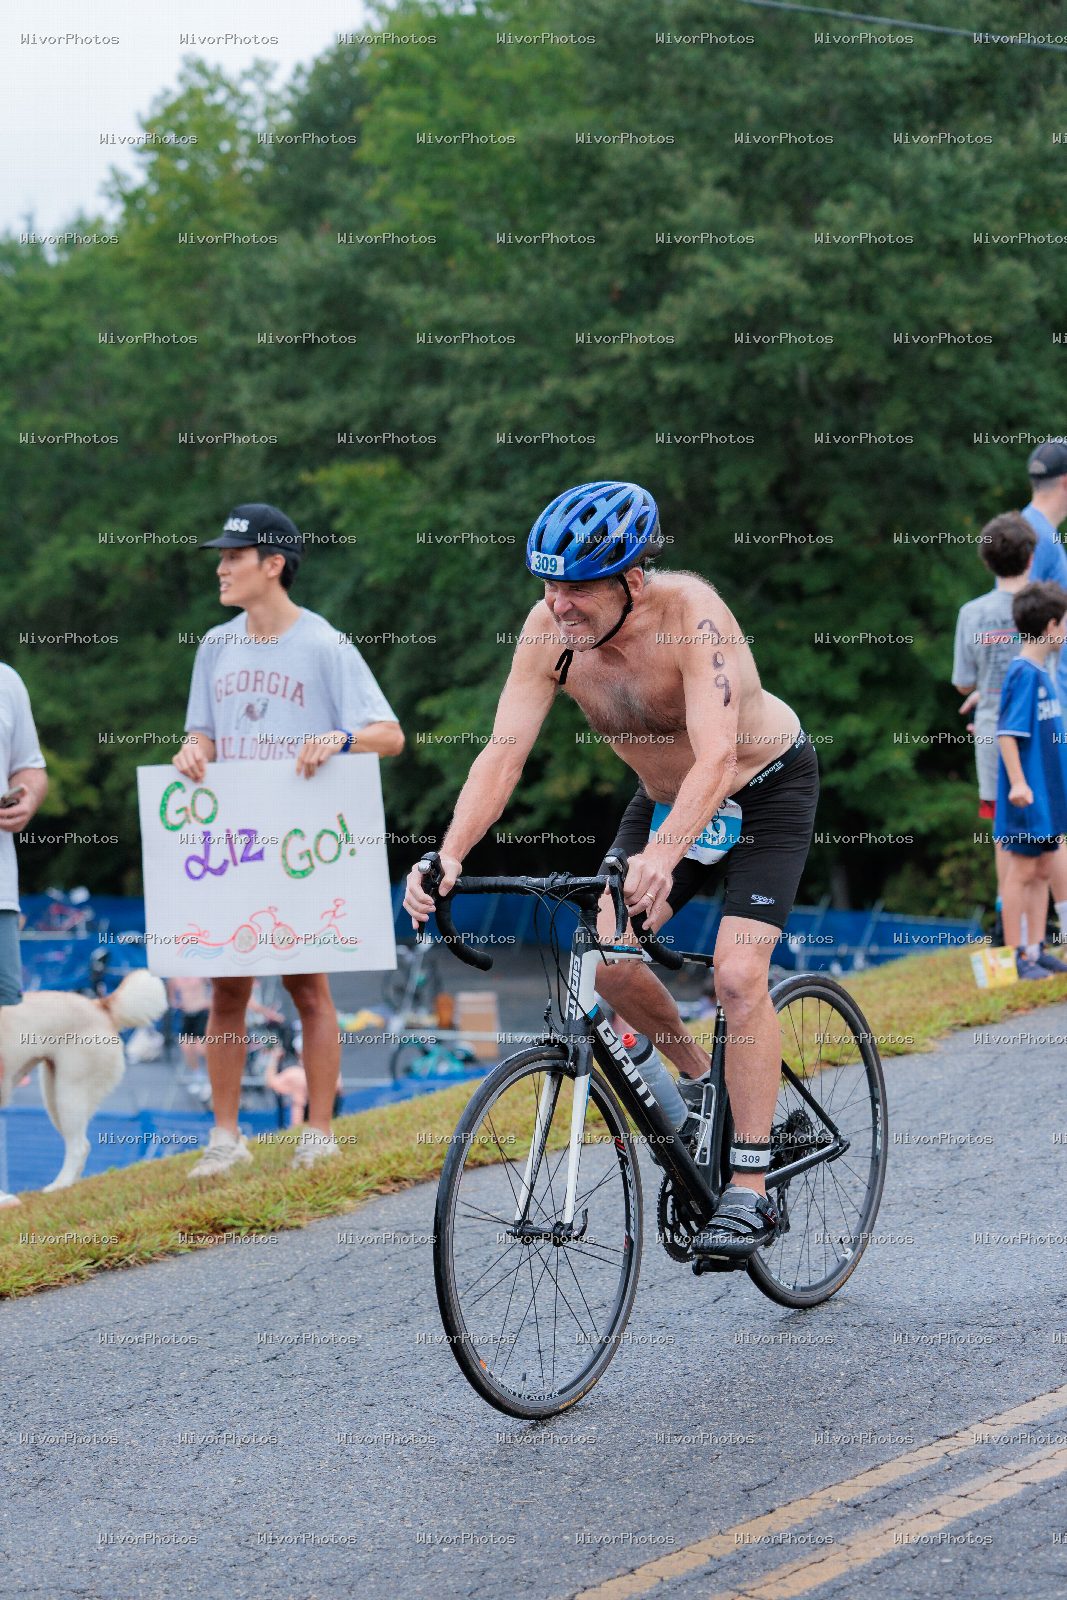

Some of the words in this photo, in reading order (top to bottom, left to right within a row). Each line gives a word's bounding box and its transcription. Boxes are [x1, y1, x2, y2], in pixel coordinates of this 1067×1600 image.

[535, 554, 557, 573] 309
[697, 619, 731, 707] 309
[214, 670, 305, 709] GEORGIA
[159, 780, 219, 832] GO
[281, 813, 356, 879] GO!
[596, 1018, 657, 1108] GIANT
[741, 1154, 761, 1164] 309
